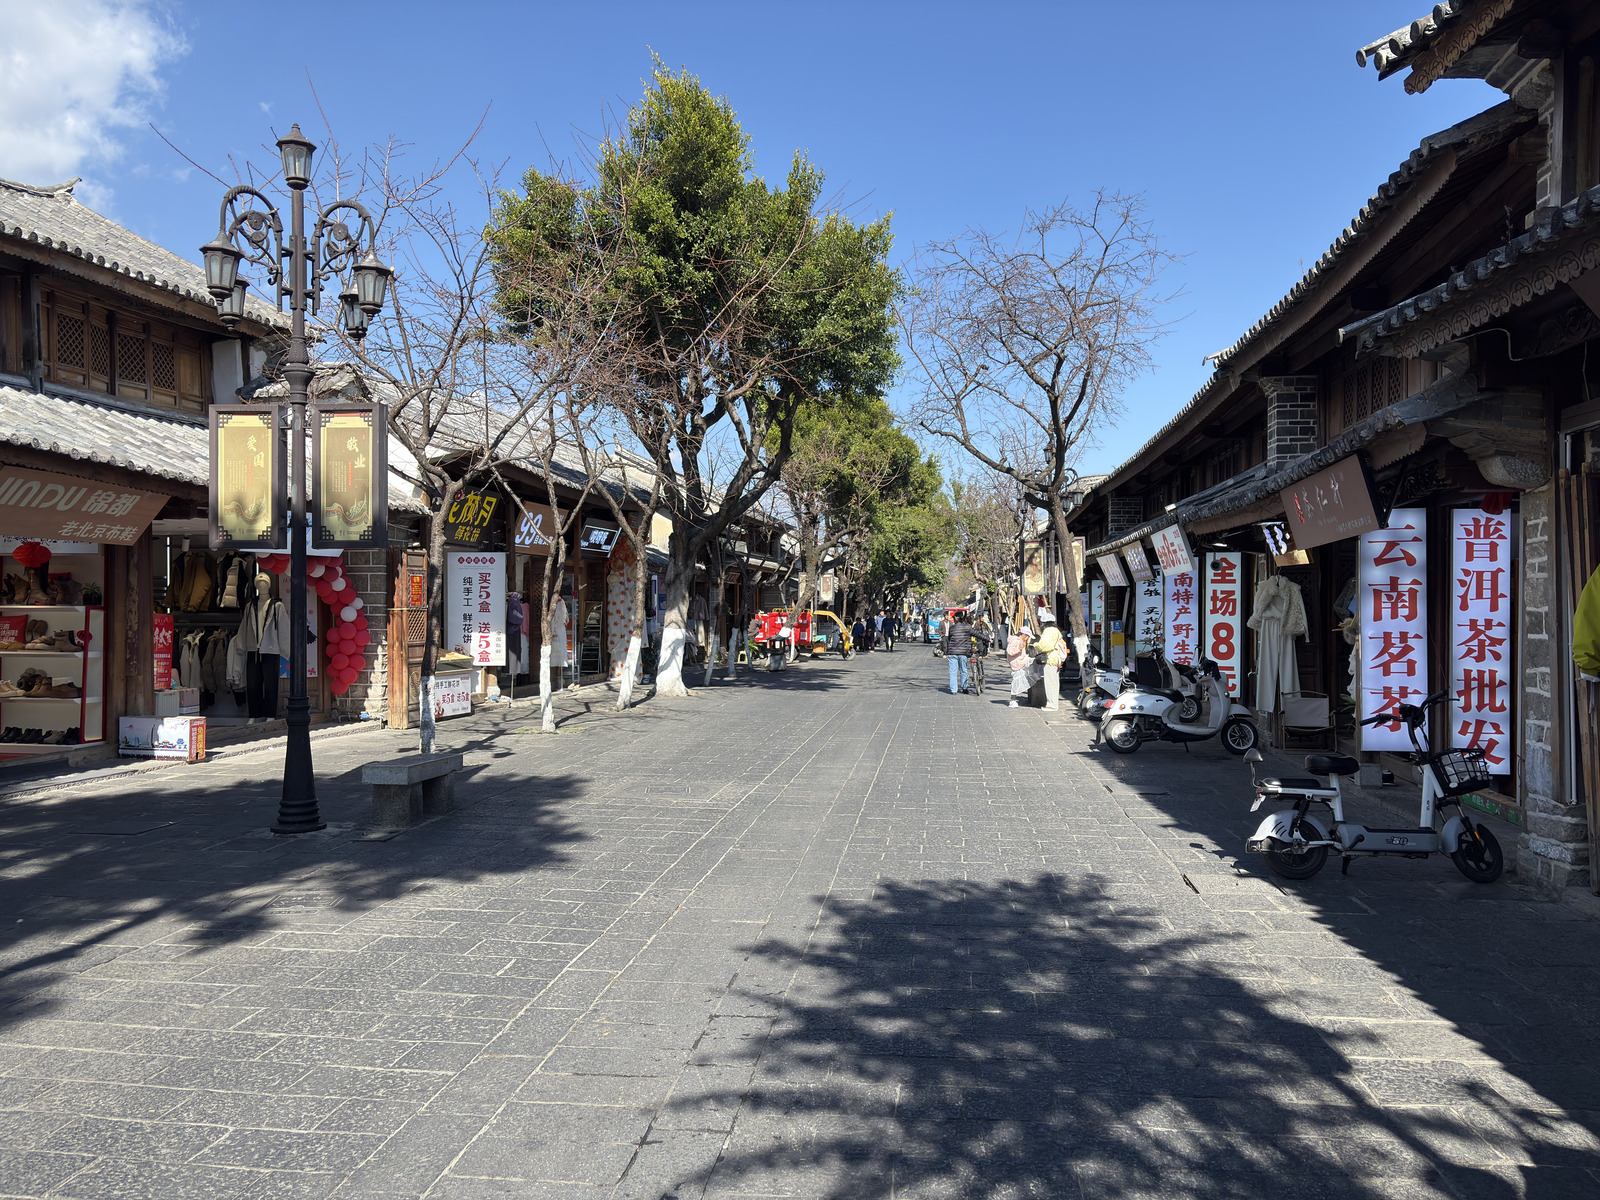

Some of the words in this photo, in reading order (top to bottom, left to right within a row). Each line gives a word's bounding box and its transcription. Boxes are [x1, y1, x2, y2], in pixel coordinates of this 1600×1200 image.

[246, 434, 265, 469] 爱国
[346, 436, 366, 469] 敬业
[81, 489, 141, 517] 锦都
[58, 520, 138, 542] 老北京布鞋
[454, 525, 480, 542] 鲜花饼
[463, 577, 473, 607] 纯手工
[478, 572, 491, 613] 买5盒
[463, 613, 473, 644] 鲜花饼
[478, 622, 491, 662] 送5盒
[1368, 524, 1423, 732] 云南茗茶
[1456, 517, 1508, 765] 普洱茶批发
[442, 693, 455, 704] 买5盒
